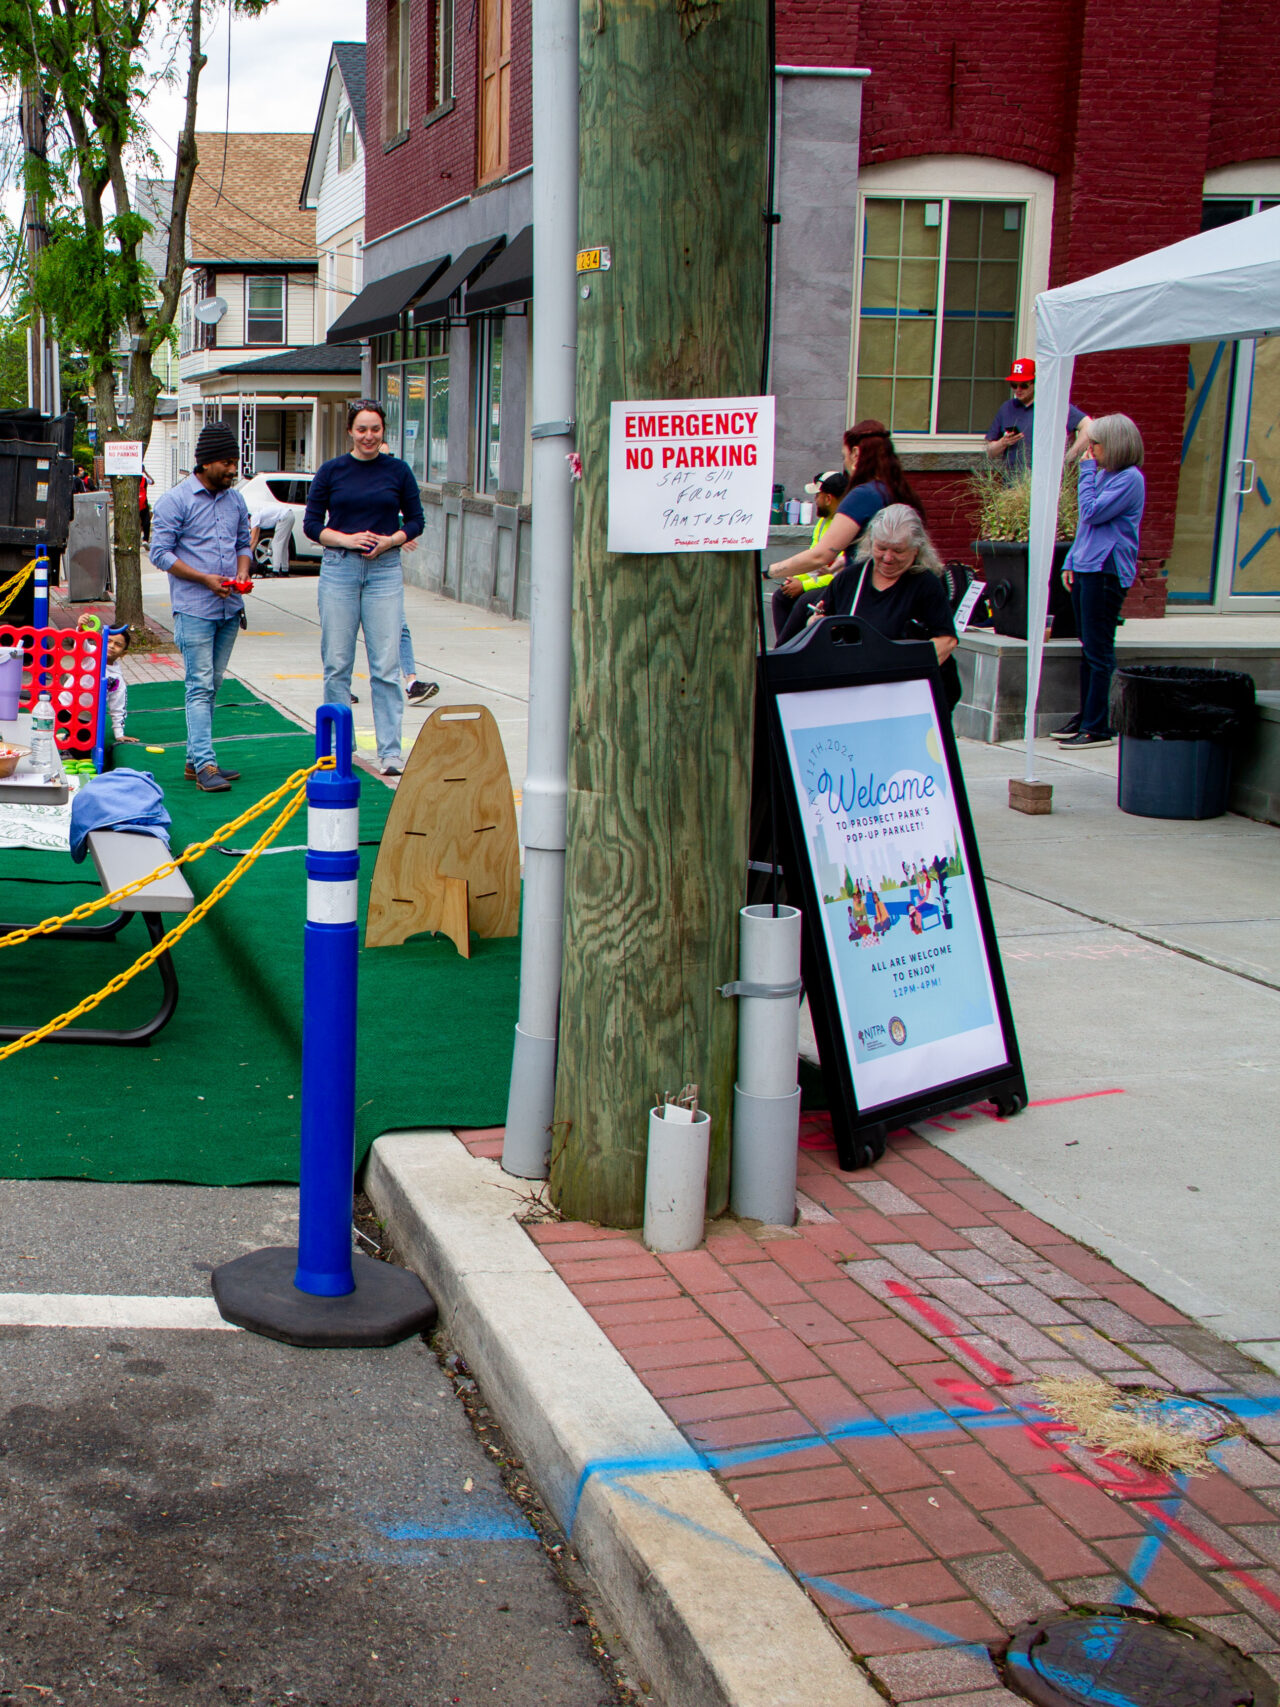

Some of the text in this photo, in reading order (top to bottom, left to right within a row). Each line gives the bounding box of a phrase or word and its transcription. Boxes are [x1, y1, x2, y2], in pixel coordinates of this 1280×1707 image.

[1013, 363, 1024, 374] R
[625, 411, 759, 438] EMERGENCY
[625, 443, 758, 470] NO PARKING
[656, 469, 733, 487] SAT 5/11
[676, 485, 728, 504] FROM
[662, 509, 689, 529] 9AM
[713, 509, 753, 526] 5PM
[674, 538, 700, 546] Prospect
[703, 537, 719, 545] Park
[721, 537, 739, 545] Police
[817, 767, 935, 814] Welcome
[835, 806, 930, 831] TO PROSPECT PARK'S
[846, 821, 925, 843] POP-UP PARKLET!
[871, 944, 953, 973] ALL ARE WELCOME
[892, 963, 936, 982] TO ENJOY
[892, 977, 942, 998] 12PM-4PM!
[863, 1024, 887, 1039] NJTPA
